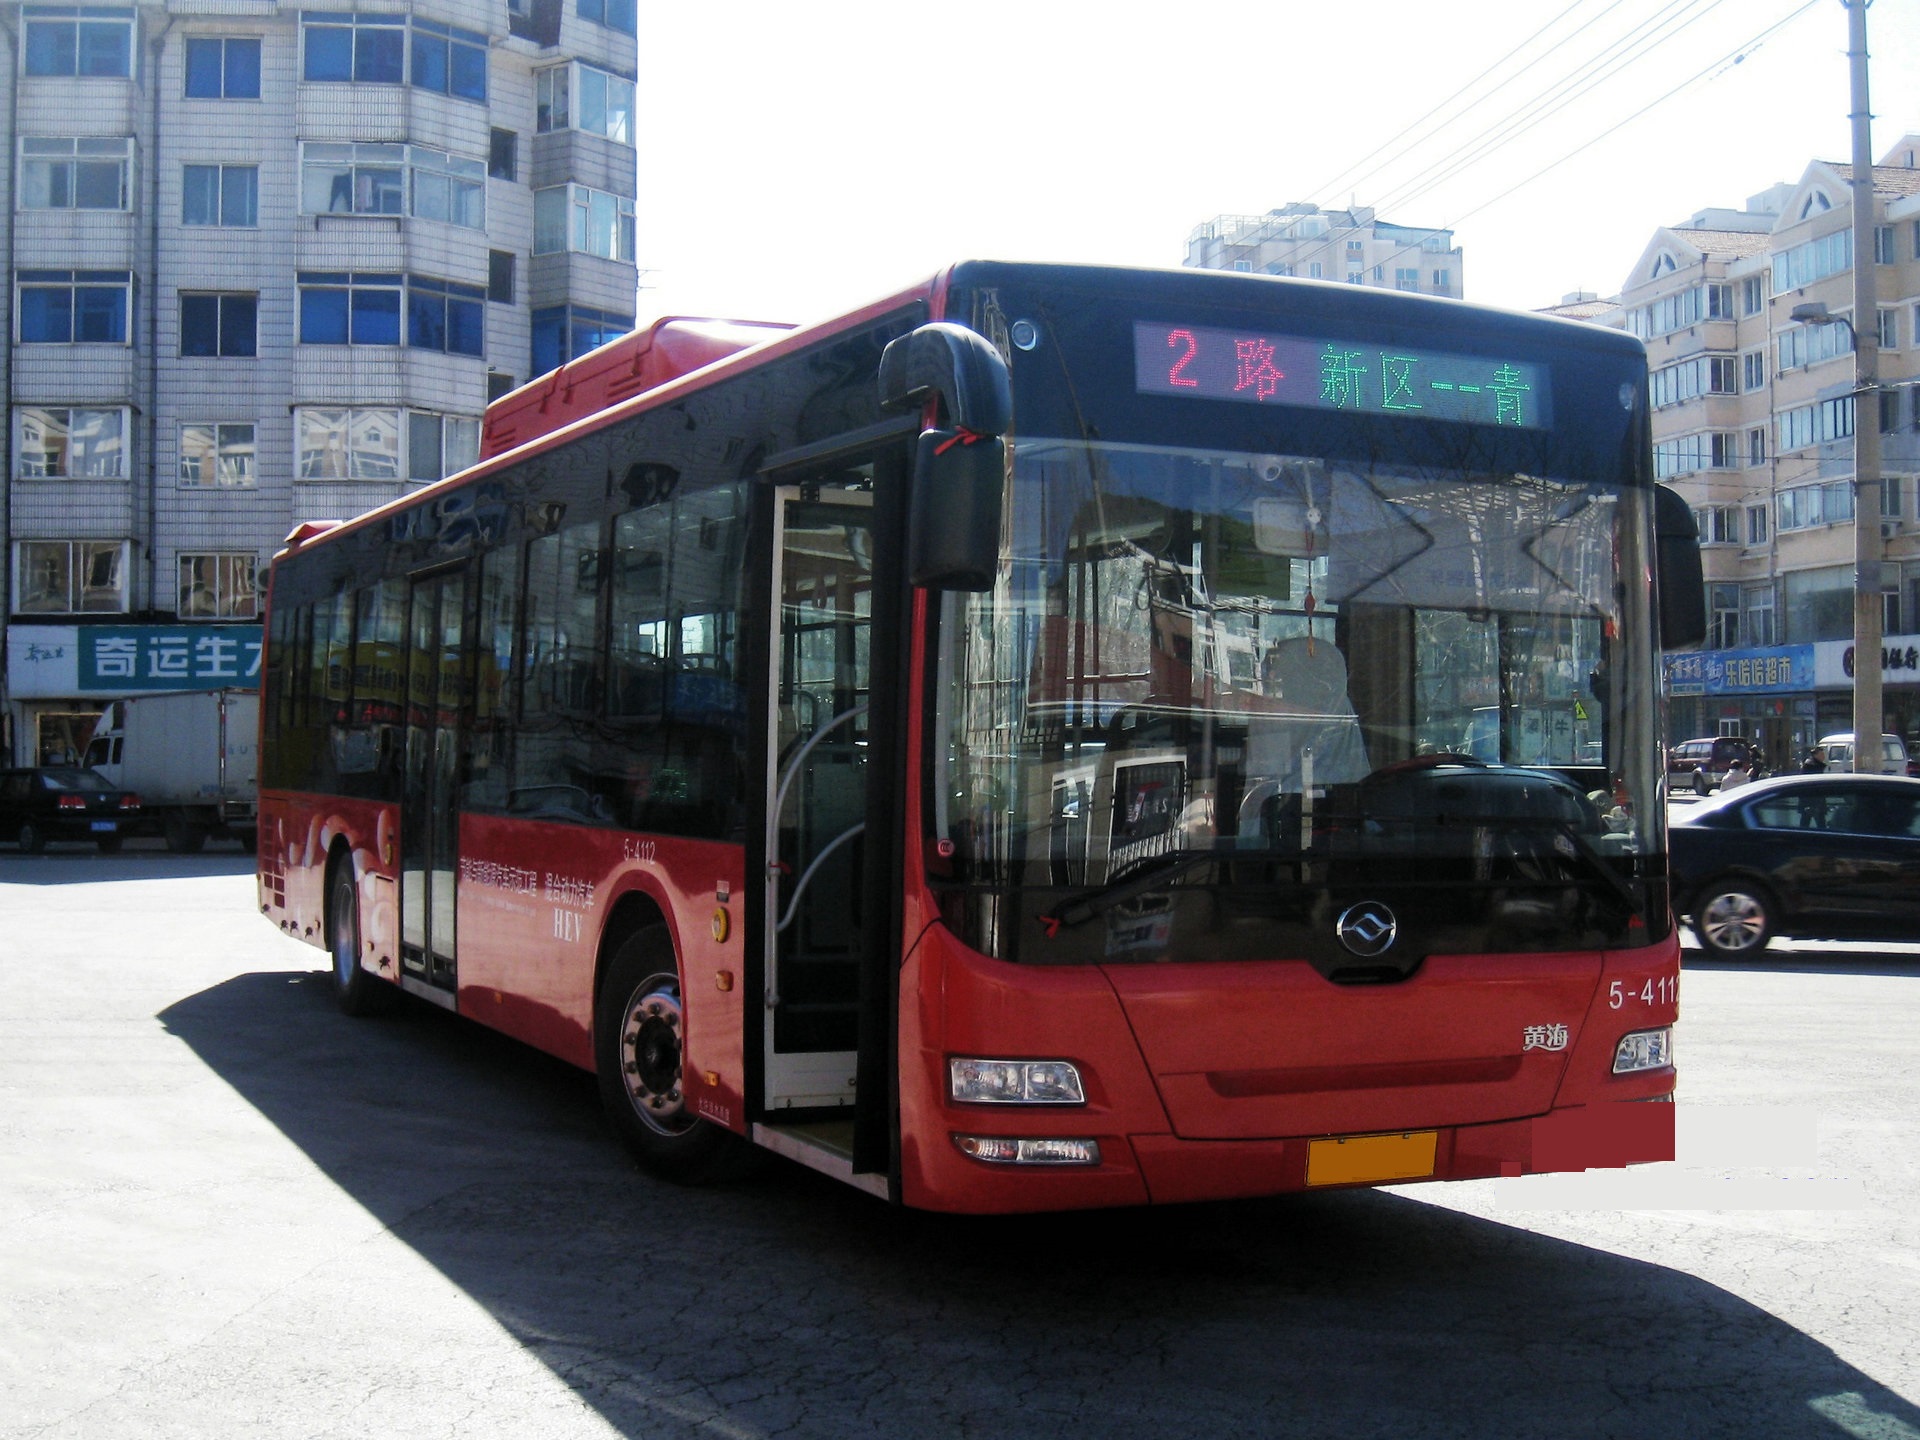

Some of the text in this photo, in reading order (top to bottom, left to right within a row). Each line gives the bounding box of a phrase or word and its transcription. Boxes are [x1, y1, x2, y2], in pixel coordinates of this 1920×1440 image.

[1167, 329, 1197, 387] 2
[1234, 338, 1284, 402] 路
[1725, 656, 1792, 688] 乐哈哈超市
[623, 837, 656, 865] 5-4112
[544, 871, 595, 910] 混合动力汽车
[554, 908, 583, 943] HEV
[1522, 1022, 1569, 1052] 黄海
